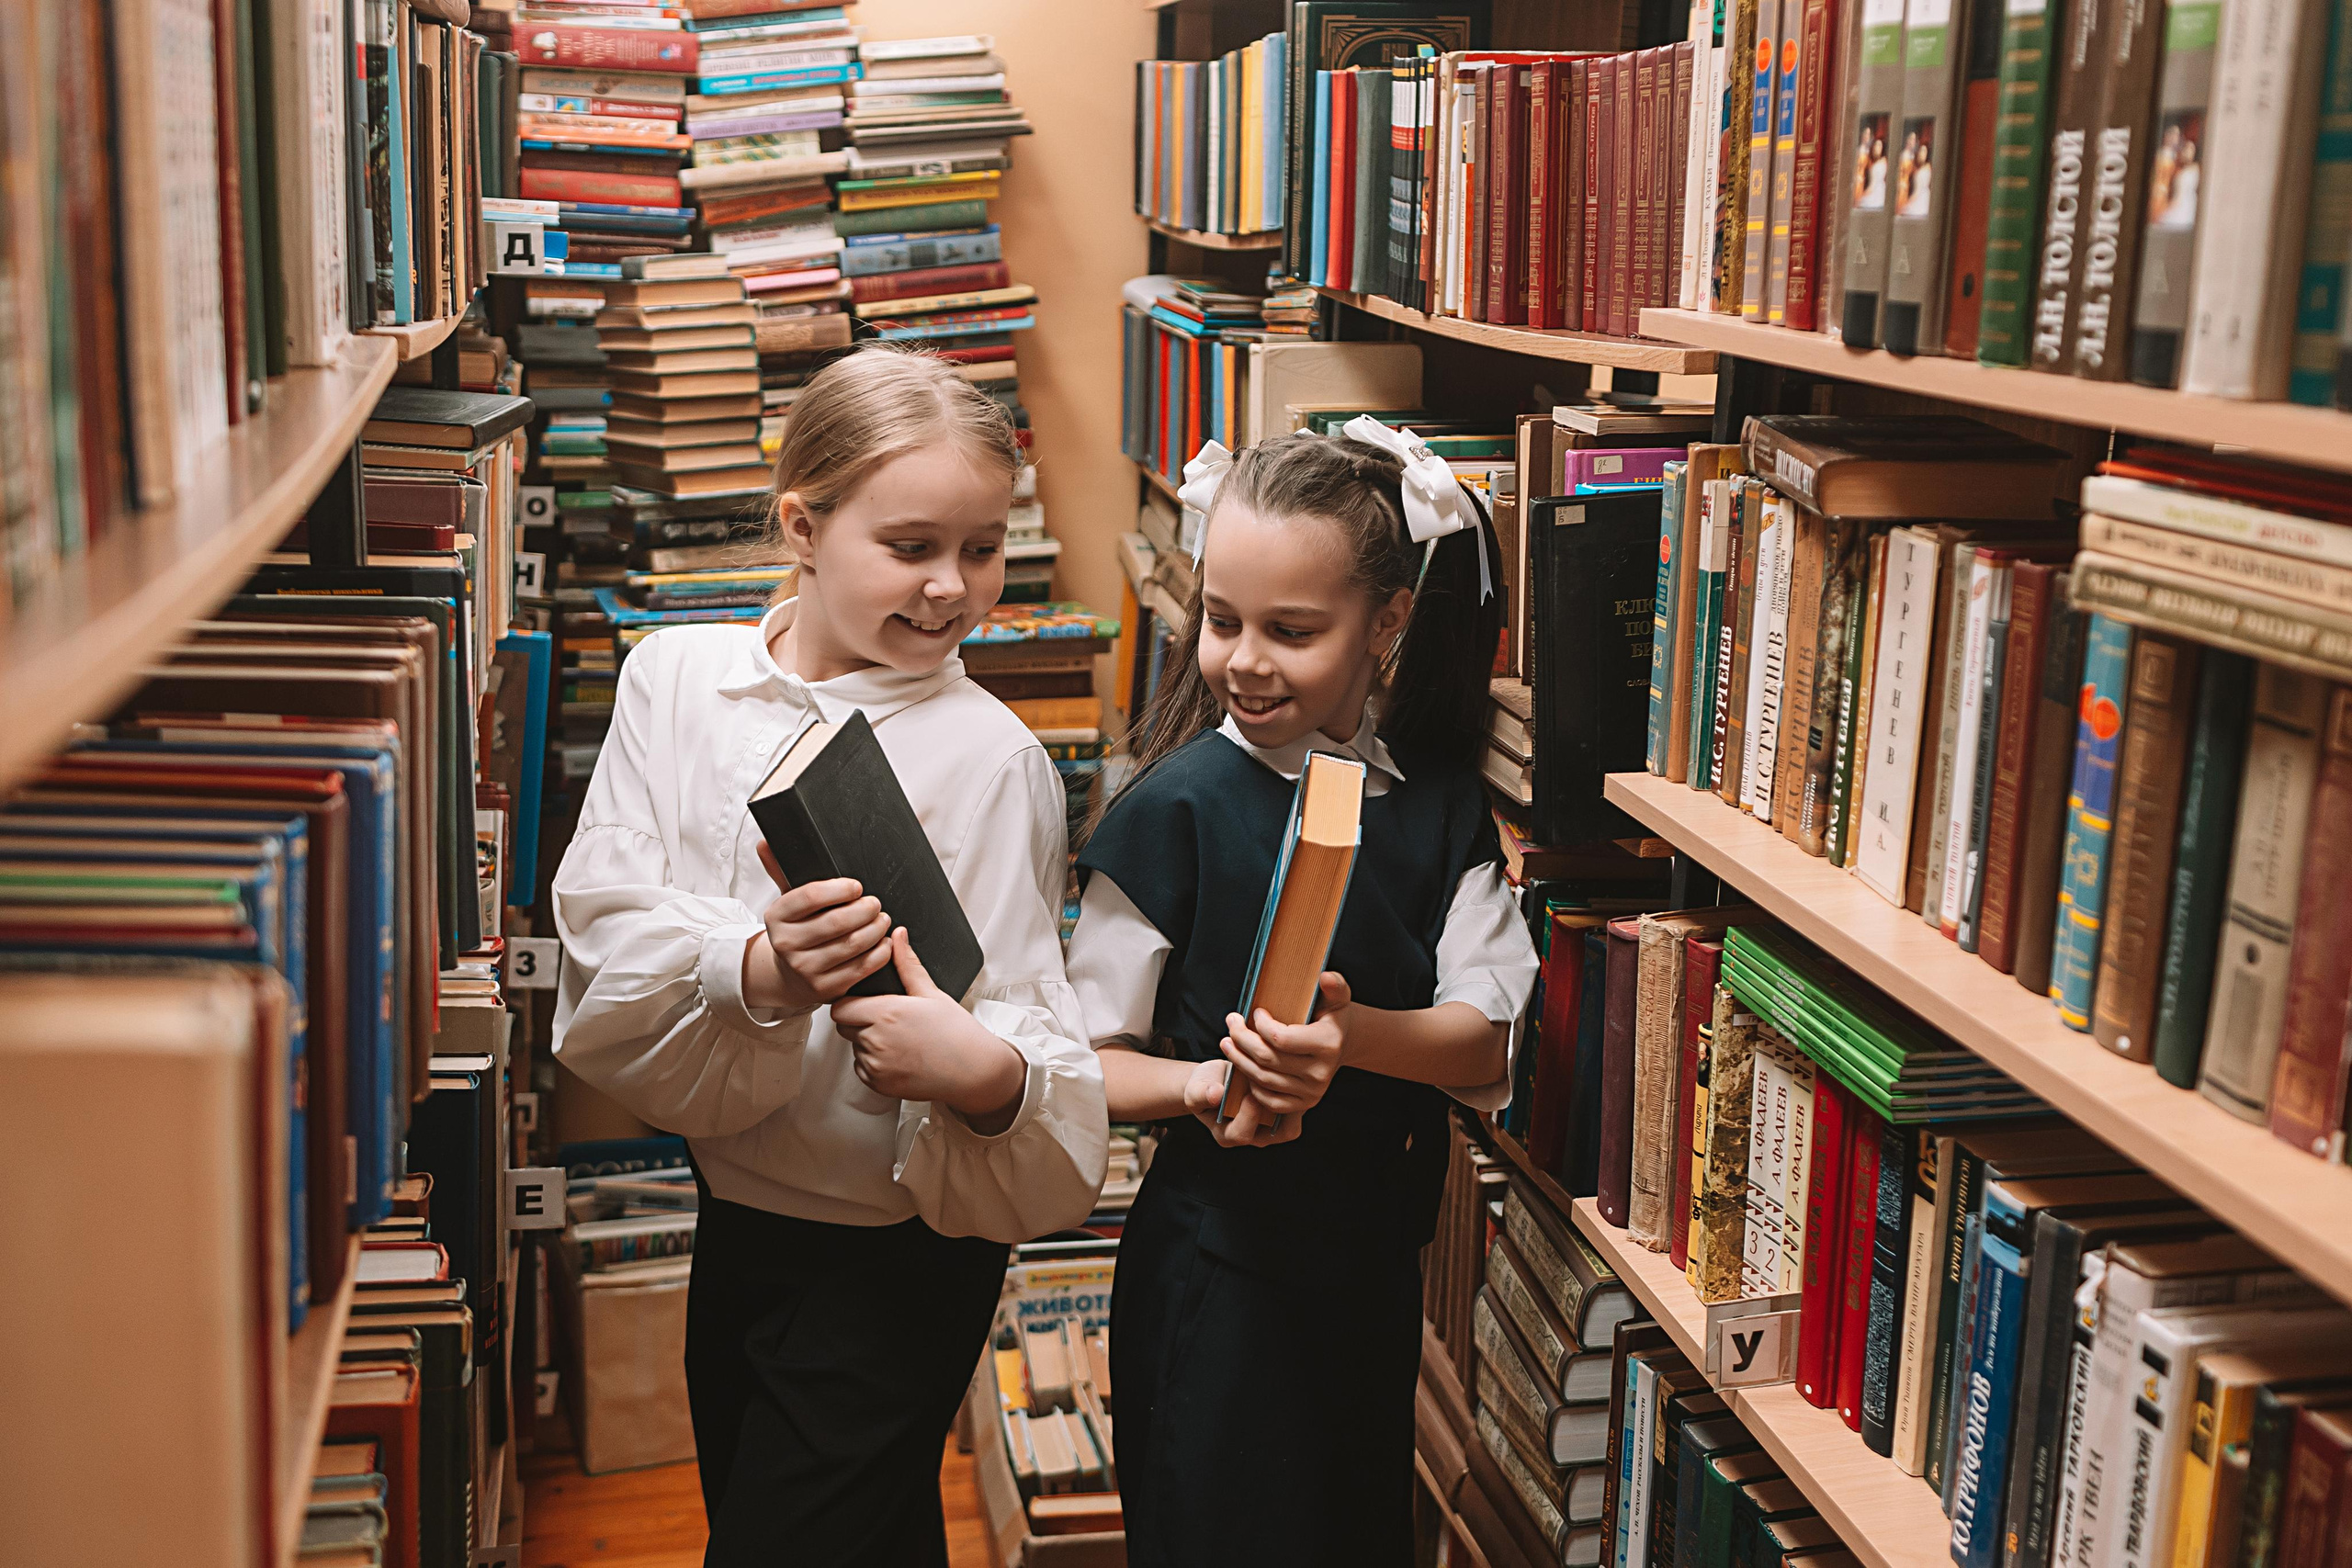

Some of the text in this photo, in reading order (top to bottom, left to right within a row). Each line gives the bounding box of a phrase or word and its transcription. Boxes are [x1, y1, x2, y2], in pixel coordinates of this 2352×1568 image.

[1807, 31, 1818, 107] ТОЛСТОЙ
[1705, 167, 1713, 209] КАЗАКИ
[2041, 129, 2086, 289] ТОЛСТОЙ
[2081, 127, 2132, 291] ТОЛСТОЙ
[503, 232, 535, 265] Д
[526, 497, 548, 515] О
[514, 562, 535, 586] Н
[1756, 578, 1764, 602] Отцы
[1759, 547, 1768, 569] дети
[1770, 514, 1783, 612] ДВОРЯНСКОЕ ГНЕЗДО
[1624, 620, 1655, 637] ПО
[1848, 581, 1861, 662] Записки охотника
[1886, 542, 1916, 764] ТУРГЕНЕВ
[1758, 631, 1783, 753] ТУРГЕНЕВ
[1965, 616, 1981, 707] Князь Серебряный
[1710, 625, 1733, 785] И.С. ТУРГЕНЕВ
[1789, 645, 1814, 770] ТУРГЕНЕВ
[1832, 678, 1853, 798] ТУРГЕНЕВ
[1744, 730, 1752, 772] ТУРГЕНЕВ
[1939, 753, 1951, 815] ТОЛСТОЙ
[1799, 782, 1810, 831] Записки
[1805, 773, 1817, 837] охотника
[1945, 820, 1962, 912] АЛЕКСЕЙ ТОЛСТОЙ
[1693, 1103, 1704, 1135] Лирика
[1754, 1070, 1769, 1170] А. ФАДЕЕВ
[1771, 1085, 1788, 1186] А. ФАДЕЕВ
[1791, 1103, 1805, 1205] А. ФАДЕЕВ
[515, 1184, 544, 1215] Е
[1808, 1149, 1826, 1259] МАРК ТВЕН
[1849, 1169, 1871, 1283] МАРК ТВЕН
[1954, 1158, 1971, 1232] ТЫНЯНОВ
[1749, 1231, 1758, 1255] 3
[1764, 1248, 1775, 1273] 2
[1949, 1235, 1963, 1283] ЮРИЙ
[1785, 1269, 1792, 1292] 1
[1989, 1268, 2004, 1334] набережной
[1731, 1330, 1764, 1372] У
[1900, 1230, 1925, 1433] Юрий Тынянов СМЕРТЬ ВАЗИР МУХТАРА
[1984, 1347, 1996, 1374] Дом
[1987, 1336, 1996, 1347] на
[1601, 1427, 1614, 1549] А. П. Чехов Пьесы
[2058, 1348, 2090, 1567] Арсений ТАРКОВСКИЙ
[2082, 1448, 2105, 1522] ТВЕН
[2125, 1427, 2154, 1555] ТВАРДОВСКИЙ
[1634, 1518, 1640, 1529] П.
